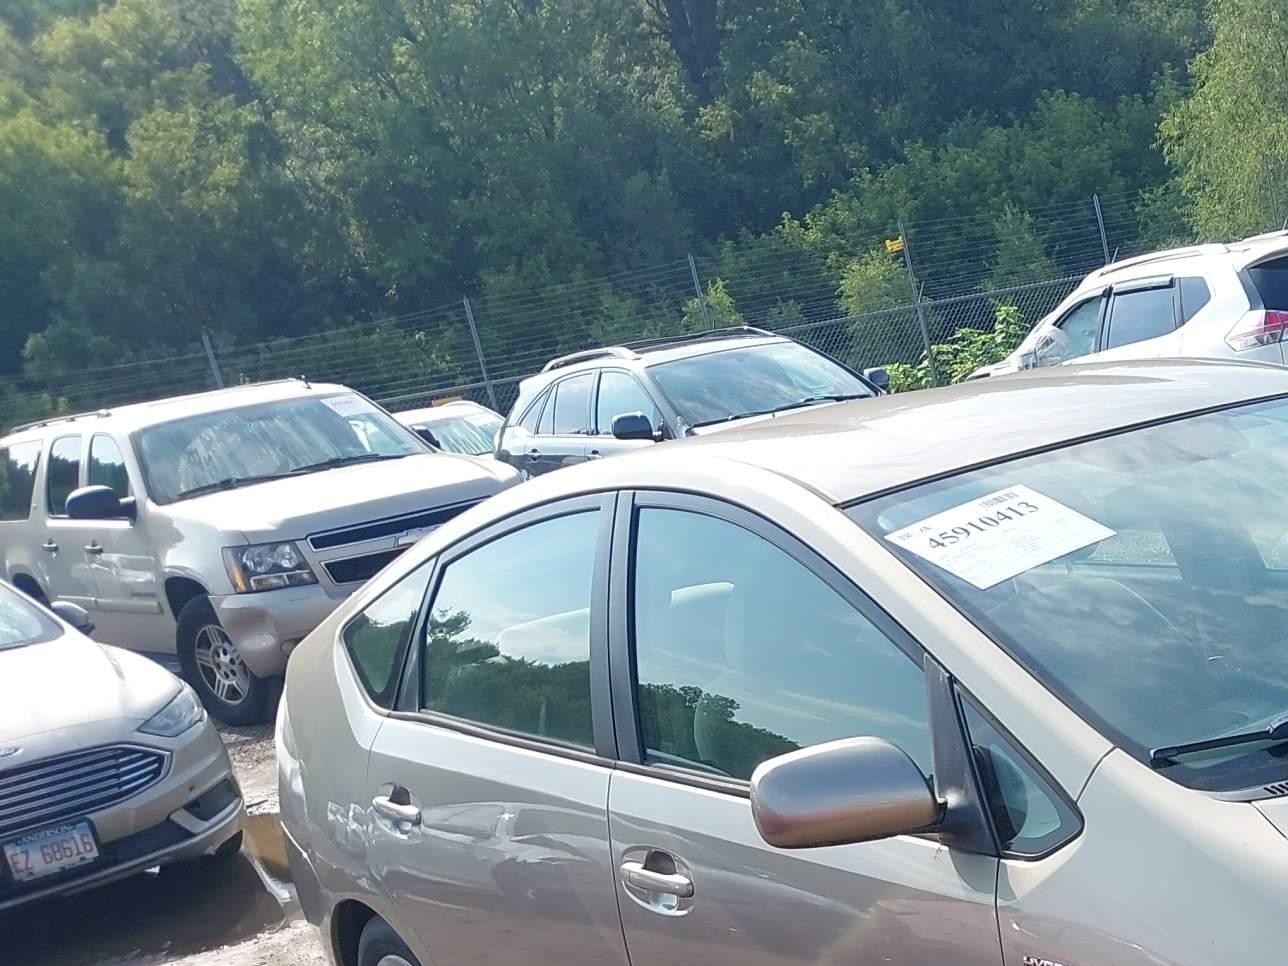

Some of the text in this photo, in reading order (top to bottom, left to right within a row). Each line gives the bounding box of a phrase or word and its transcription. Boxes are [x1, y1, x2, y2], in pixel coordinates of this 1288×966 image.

[927, 500, 1041, 550] 45910413
[10, 832, 94, 875] EZ 68616
